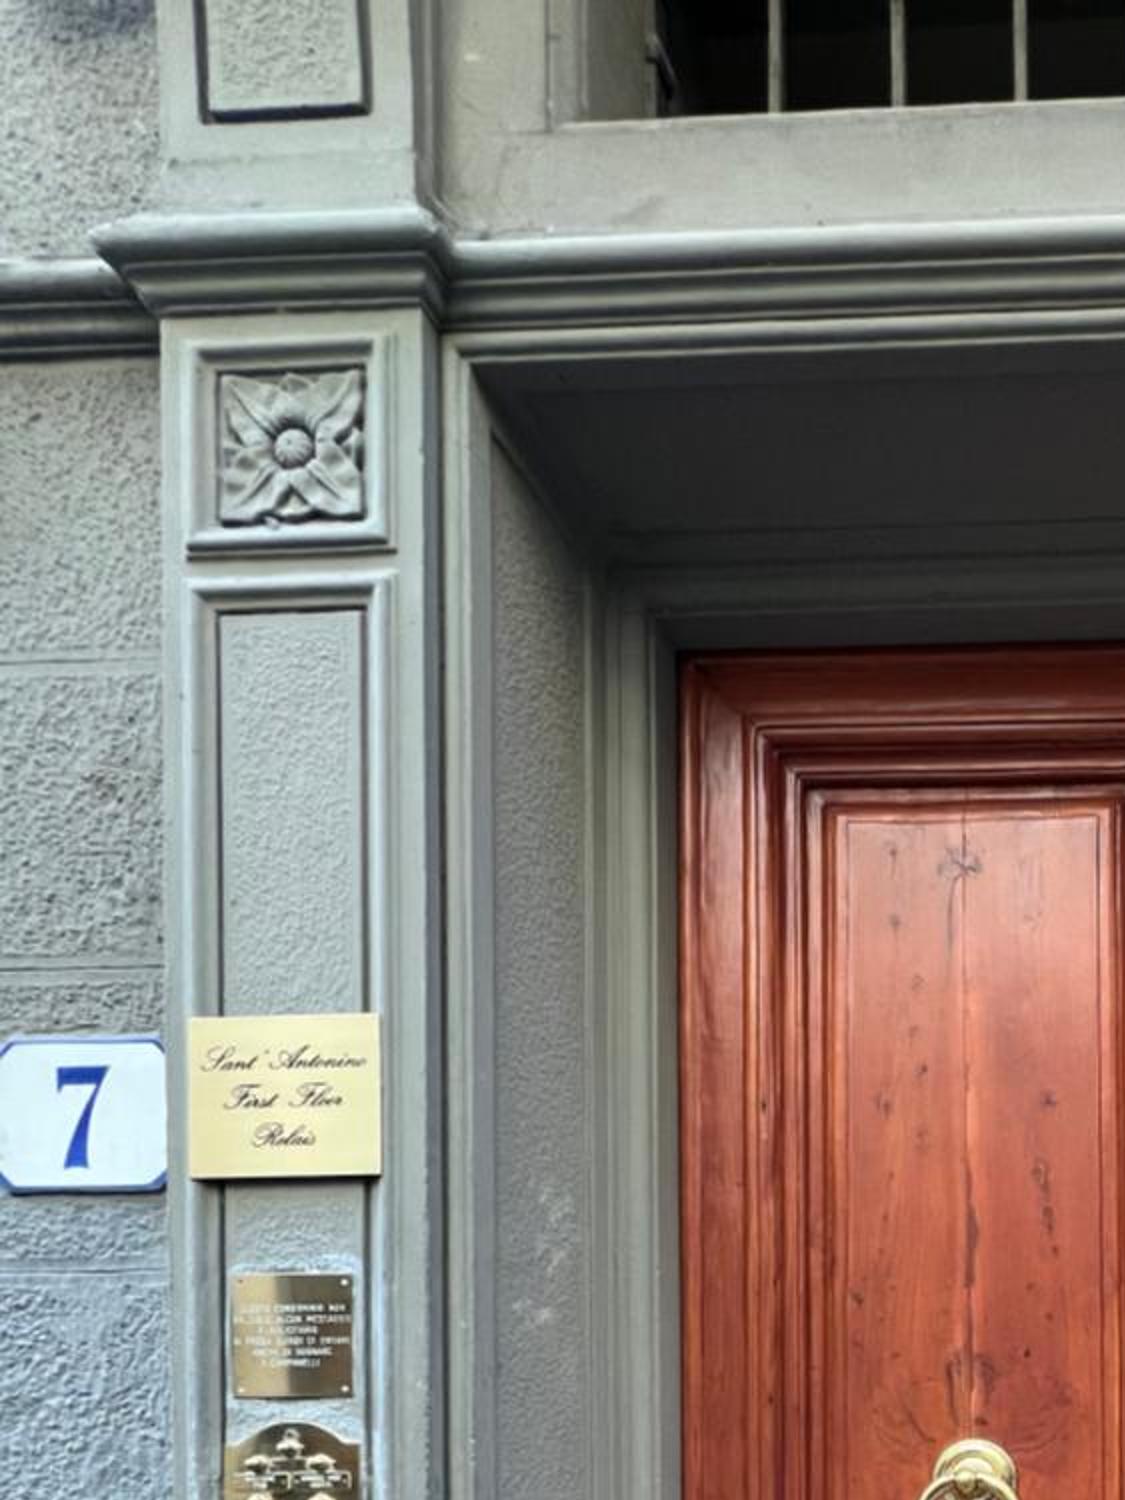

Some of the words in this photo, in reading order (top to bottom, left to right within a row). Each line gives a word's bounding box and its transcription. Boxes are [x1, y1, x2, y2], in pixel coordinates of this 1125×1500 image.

[223, 1083, 278, 1110] First
[287, 1081, 344, 1108] Floor
[57, 1066, 110, 1169] 7
[252, 1121, 317, 1148] Relais
